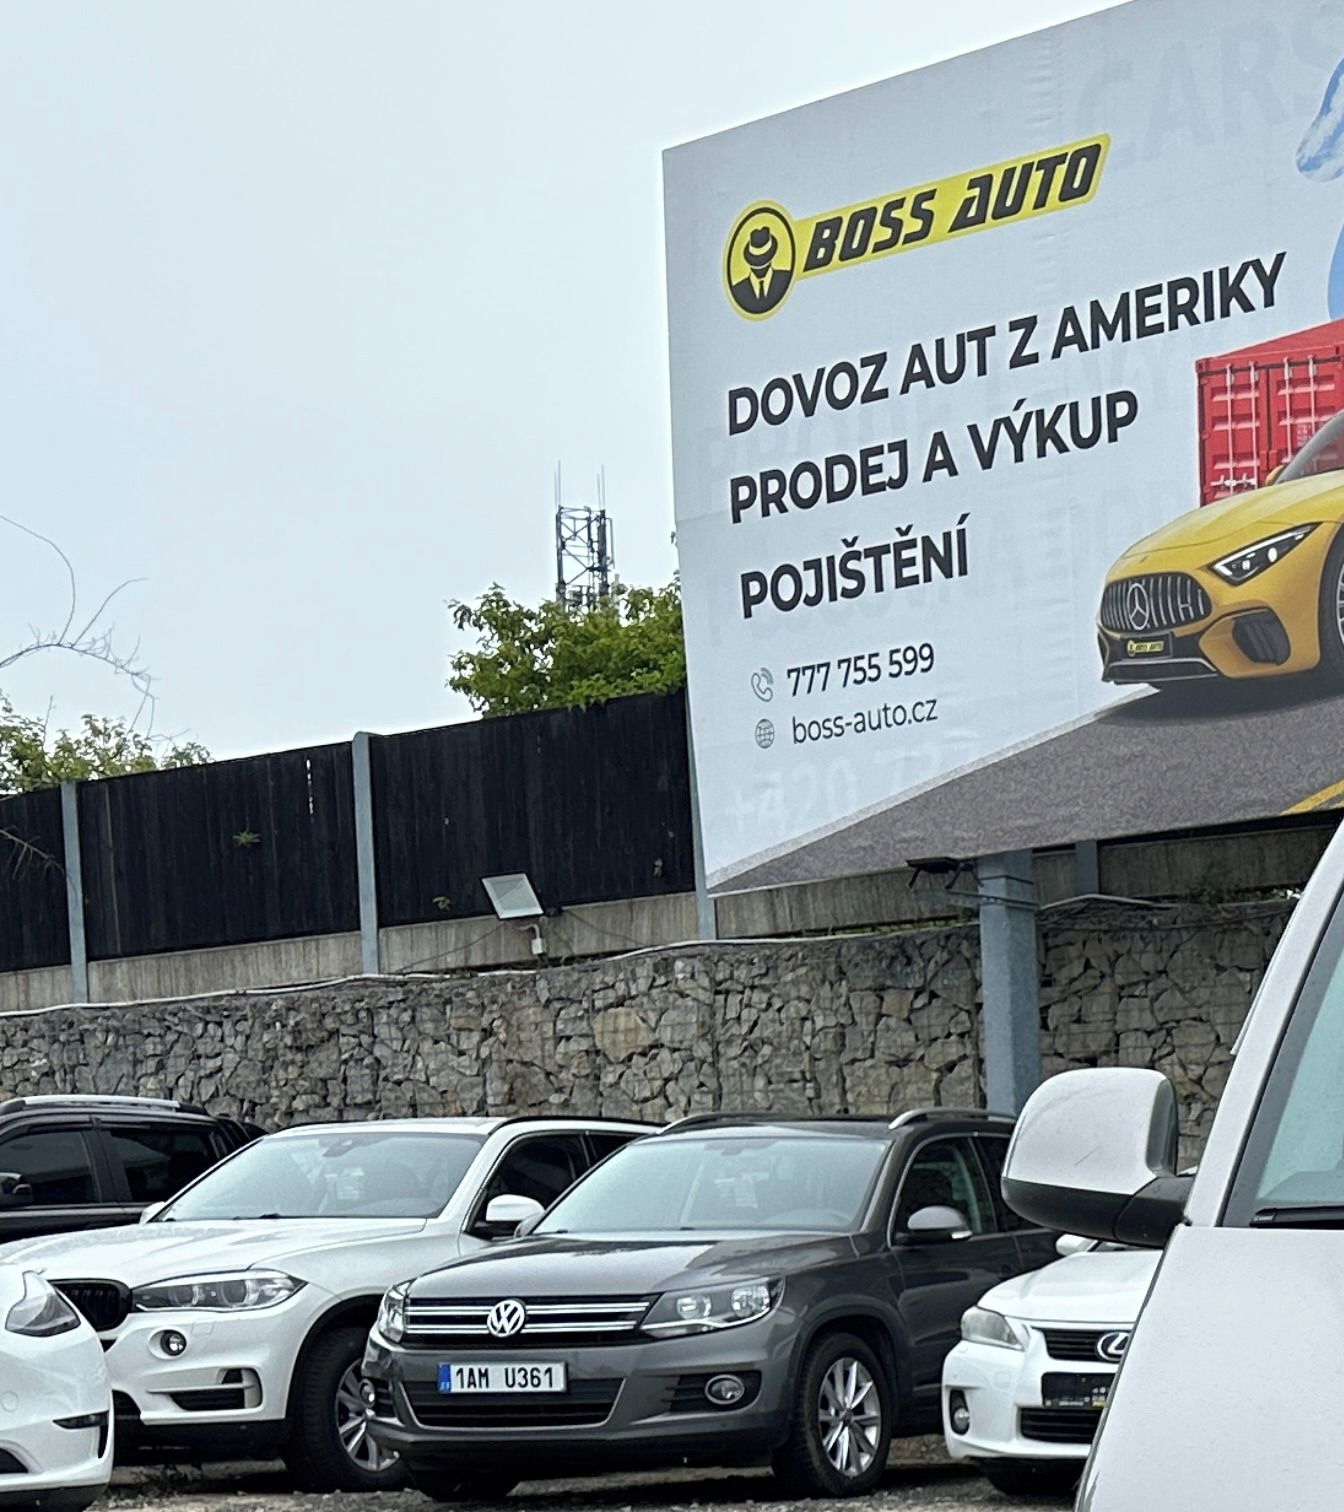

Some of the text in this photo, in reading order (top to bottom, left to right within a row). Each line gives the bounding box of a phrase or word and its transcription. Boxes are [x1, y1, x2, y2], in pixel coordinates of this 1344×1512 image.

[803, 143, 1102, 273] BOSS AUTO
[727, 251, 1288, 436] DOVOZ AUT Z AMERIKY
[730, 390, 1139, 525] PRODEJ A VÝKUP
[740, 512, 971, 619] POJIŠTĚNÍ
[787, 642, 935, 697] 777 755 599
[792, 698, 938, 745] boss-auto.cz
[456, 1366, 554, 1389] 1AM U361
